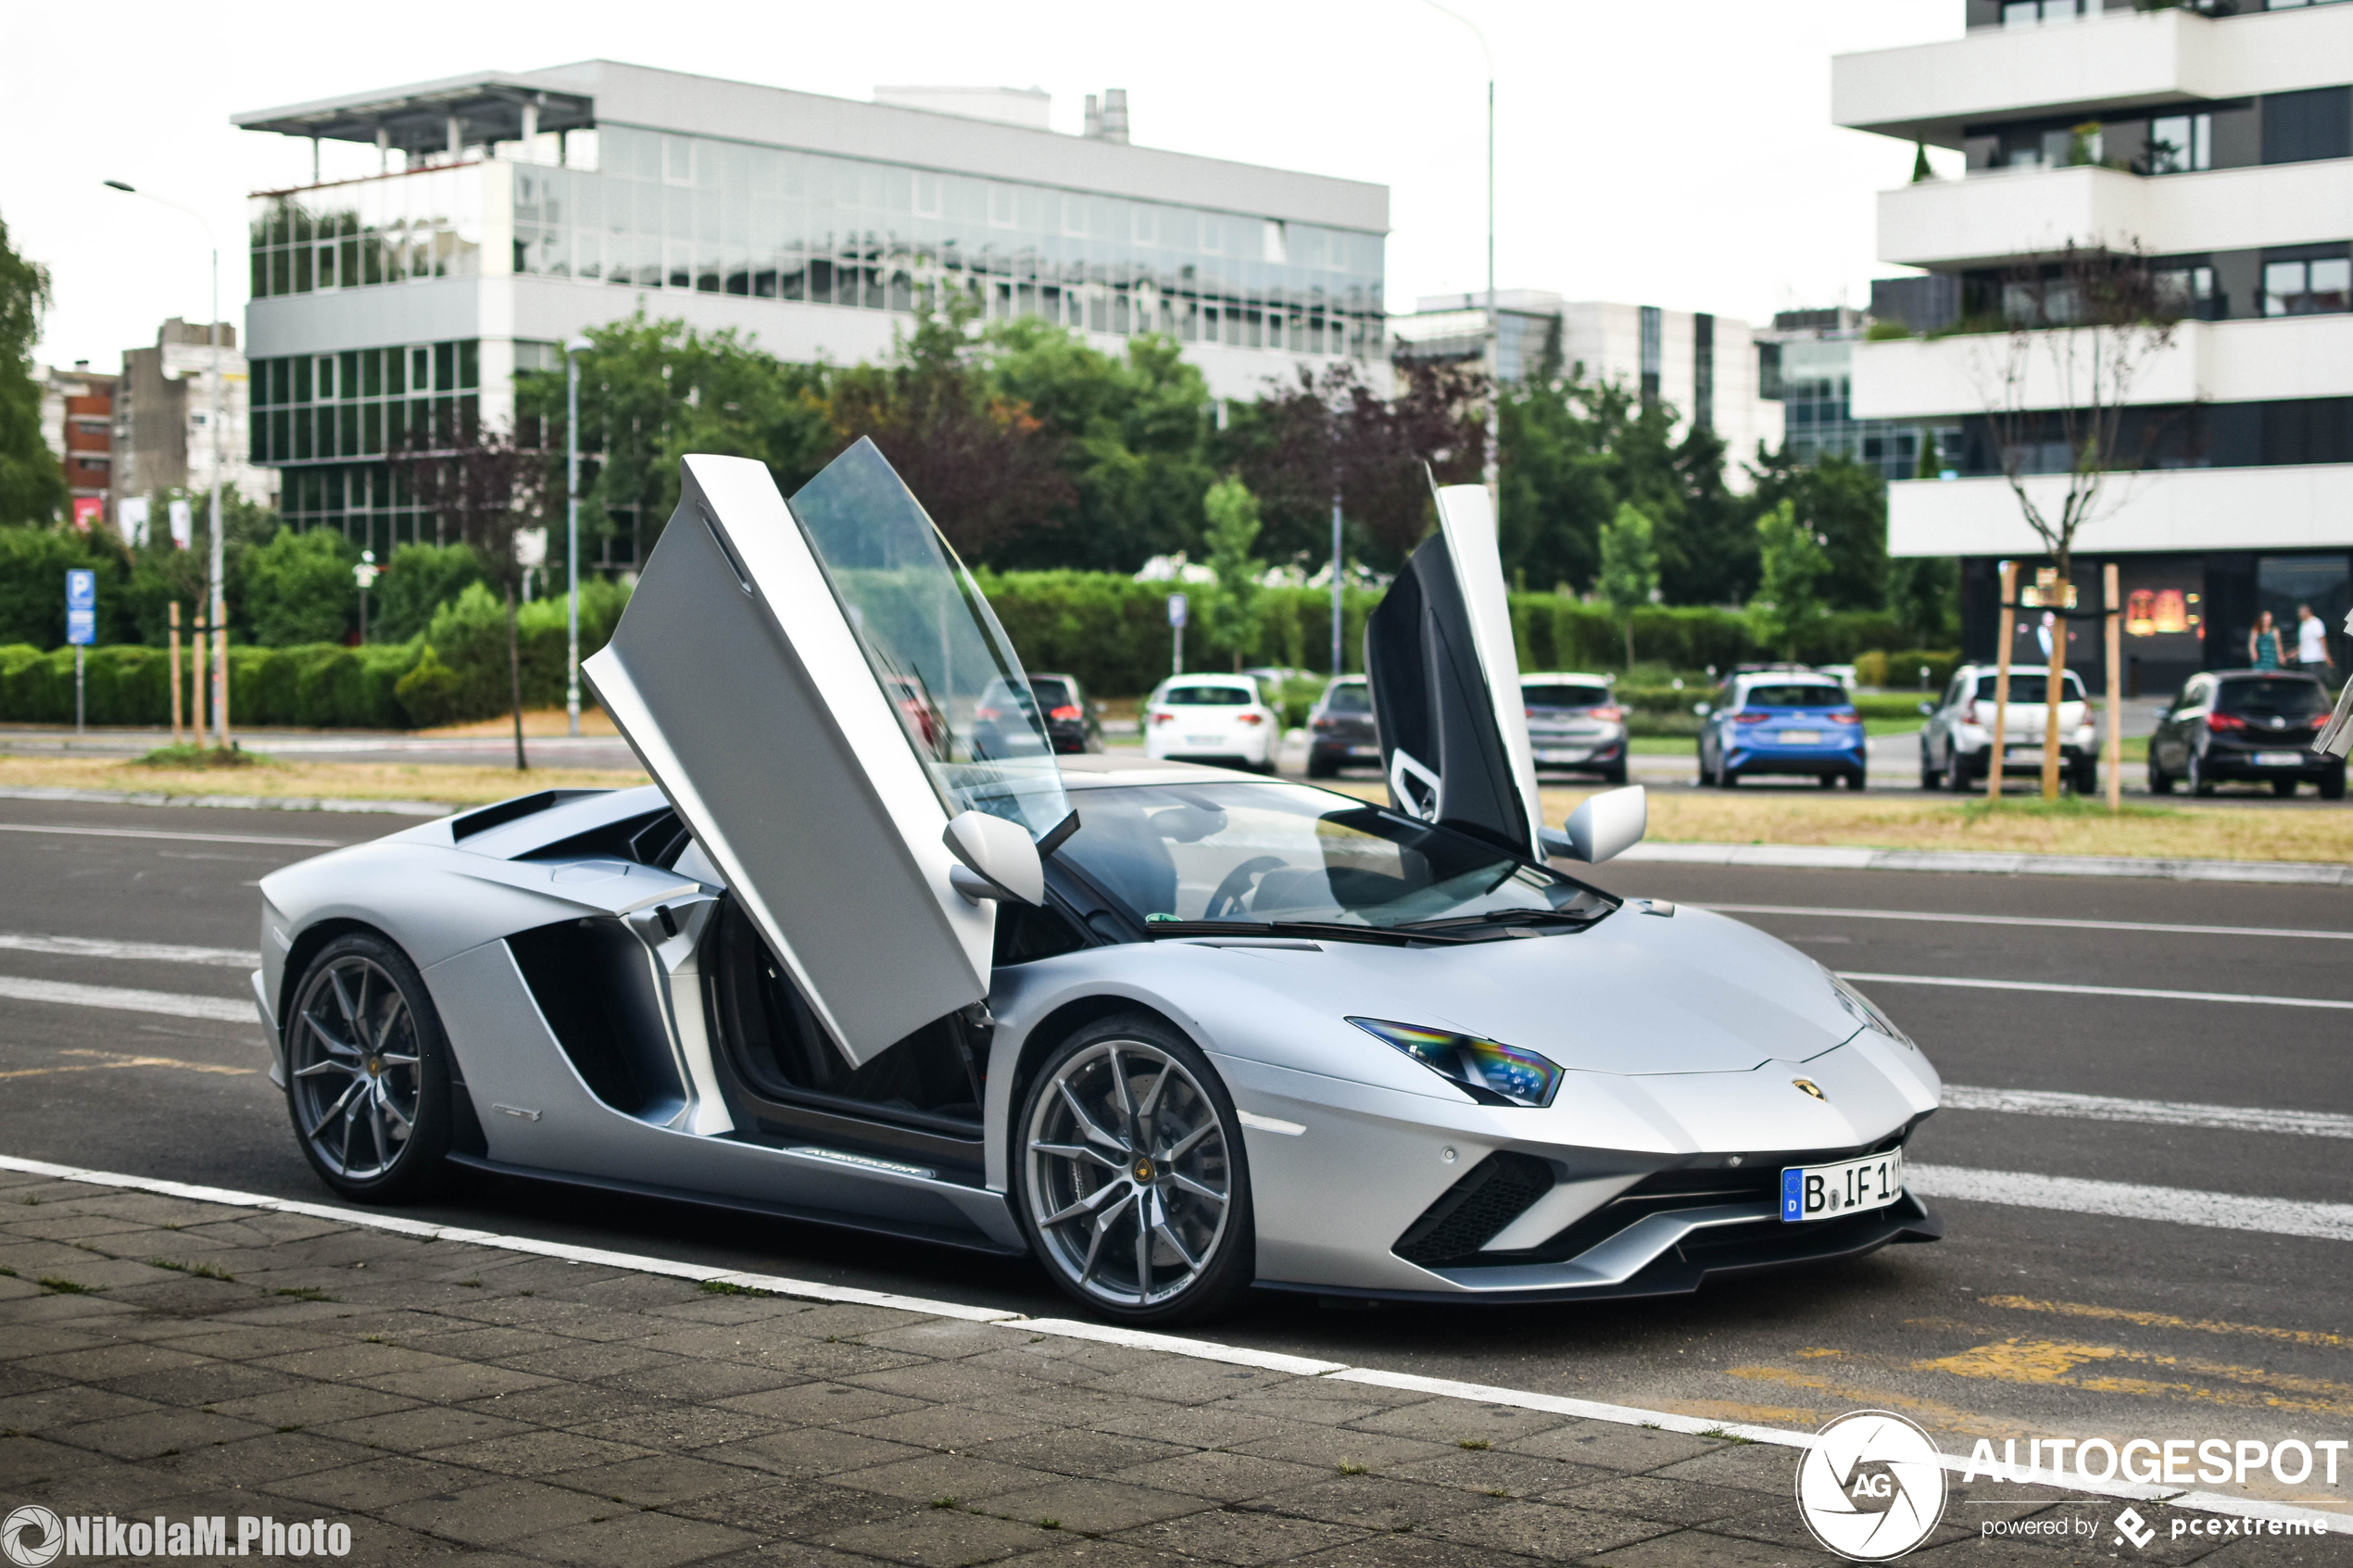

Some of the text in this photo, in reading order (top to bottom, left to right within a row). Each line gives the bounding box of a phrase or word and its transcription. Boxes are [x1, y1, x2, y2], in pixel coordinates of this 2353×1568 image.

[72, 572, 89, 598] P
[1805, 1174, 1826, 1213] B
[1843, 1165, 1872, 1208] IF
[1788, 1199, 1797, 1212] D
